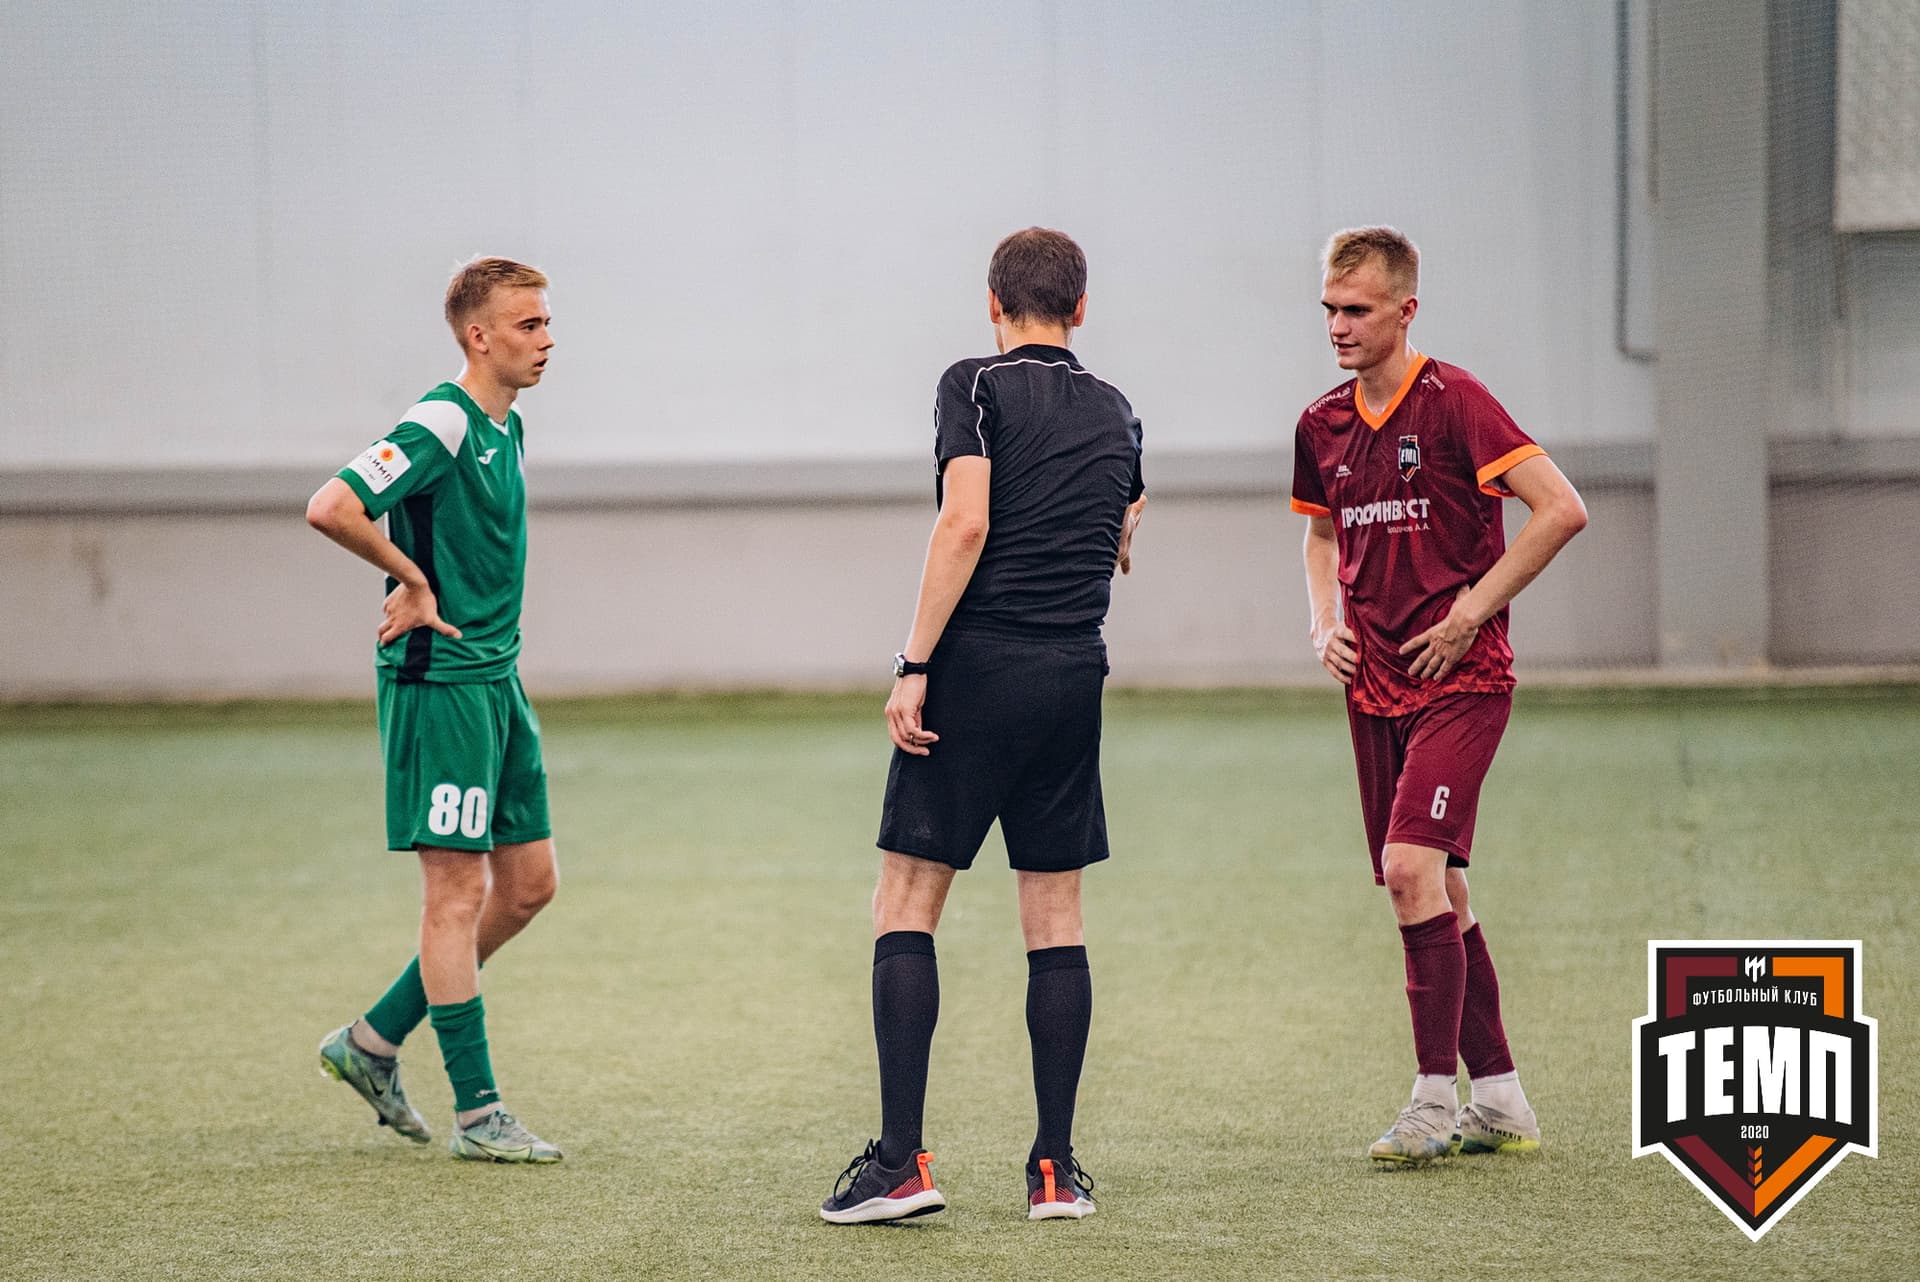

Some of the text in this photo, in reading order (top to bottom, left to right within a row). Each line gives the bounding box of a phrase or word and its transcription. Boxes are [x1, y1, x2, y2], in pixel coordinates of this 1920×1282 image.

[363, 450, 394, 483] ЛИМП
[428, 783, 488, 839] 80
[1430, 785, 1450, 820] 6
